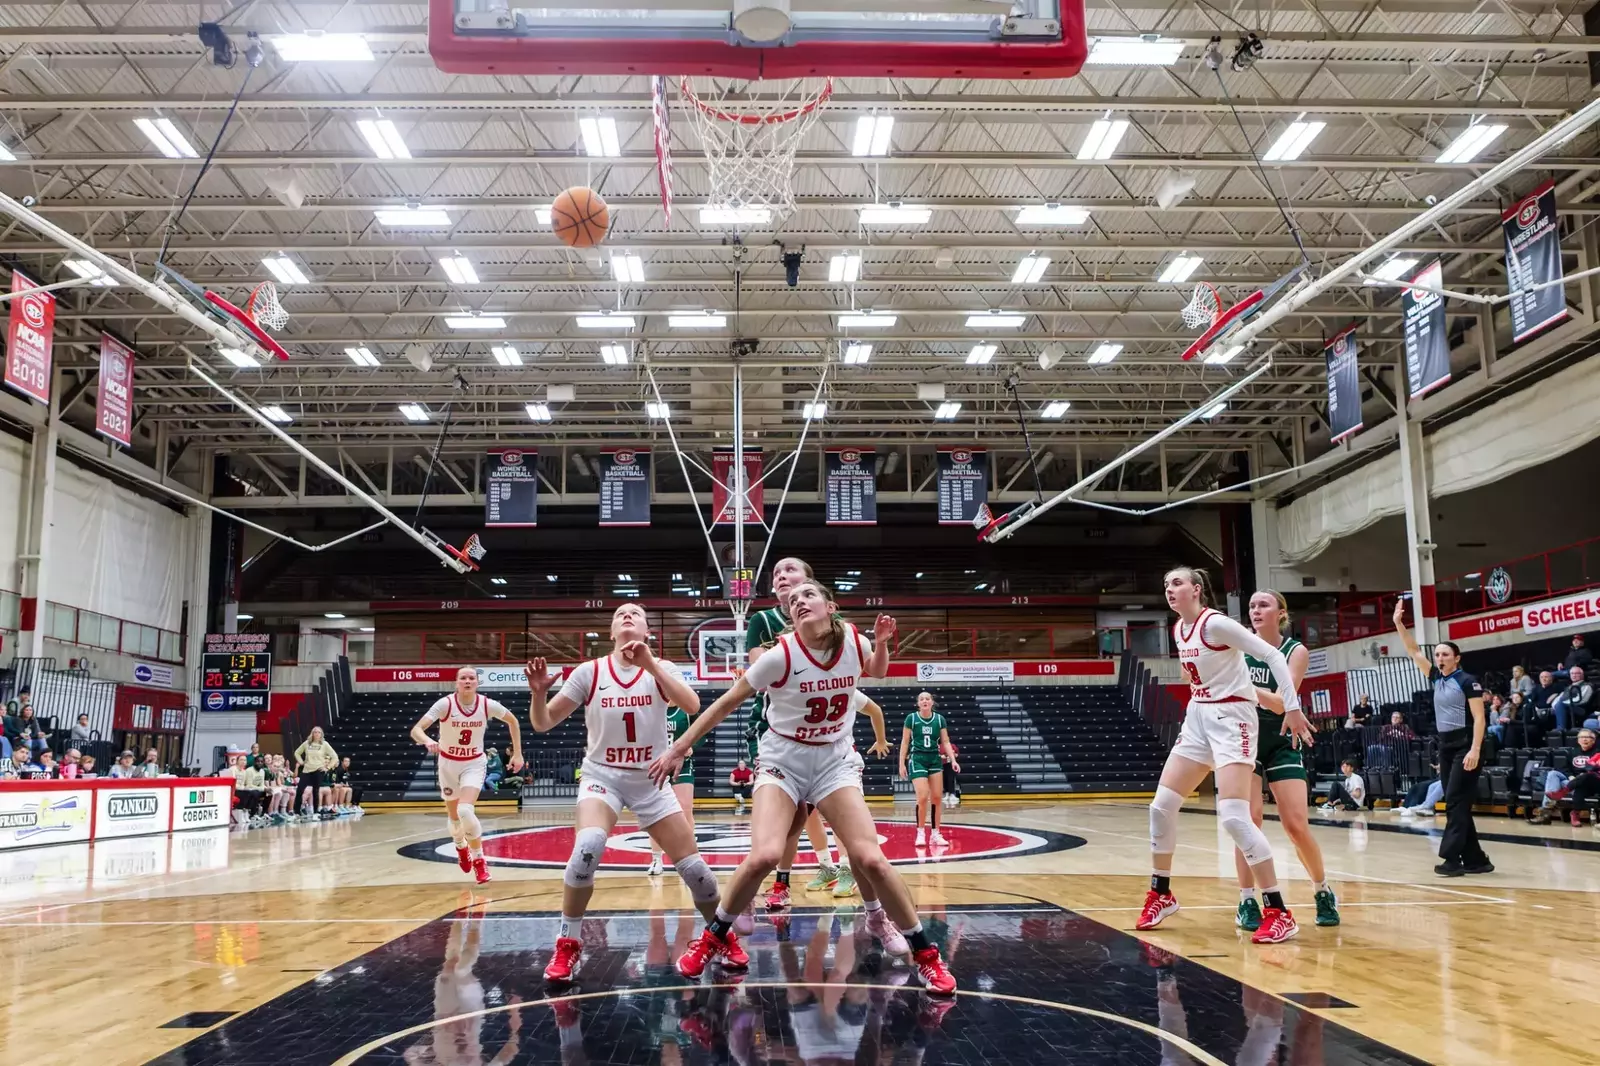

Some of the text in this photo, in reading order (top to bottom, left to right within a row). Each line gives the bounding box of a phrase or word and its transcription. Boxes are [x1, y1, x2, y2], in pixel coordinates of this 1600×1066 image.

[1511, 215, 1549, 247] WRESTLING
[17, 322, 45, 351] NCAA
[12, 358, 45, 390] 2019
[105, 377, 127, 400] NCAA
[103, 409, 127, 434] 2021
[729, 580, 751, 597] 30
[441, 600, 459, 609] 209
[585, 600, 603, 608] 210
[694, 599, 712, 607] 211
[866, 597, 884, 605] 212
[1011, 596, 1029, 604] 213
[1478, 615, 1520, 633] 110 RESERVED
[208, 643, 267, 653] SCHOLARSHIP
[231, 655, 255, 668] 1:37
[392, 671, 412, 680] 106
[1038, 665, 1057, 673] 109
[1249, 666, 1270, 684] BSU
[206, 673, 223, 687] 20
[232, 673, 239, 682] 2
[488, 672, 527, 682] Centra
[799, 676, 854, 693] ST. CLOUD
[228, 696, 263, 705] PEPSI
[601, 695, 652, 708] ST. CLOUD
[804, 693, 849, 724] 33
[622, 712, 636, 743] 1
[667, 720, 677, 731] SU
[458, 729, 473, 746] 3
[923, 735, 931, 748] 0
[1238, 722, 1250, 757] HUSKIES
[448, 746, 478, 756] STATE
[605, 745, 653, 763] STATE
[109, 798, 156, 816] FRANKLIN
